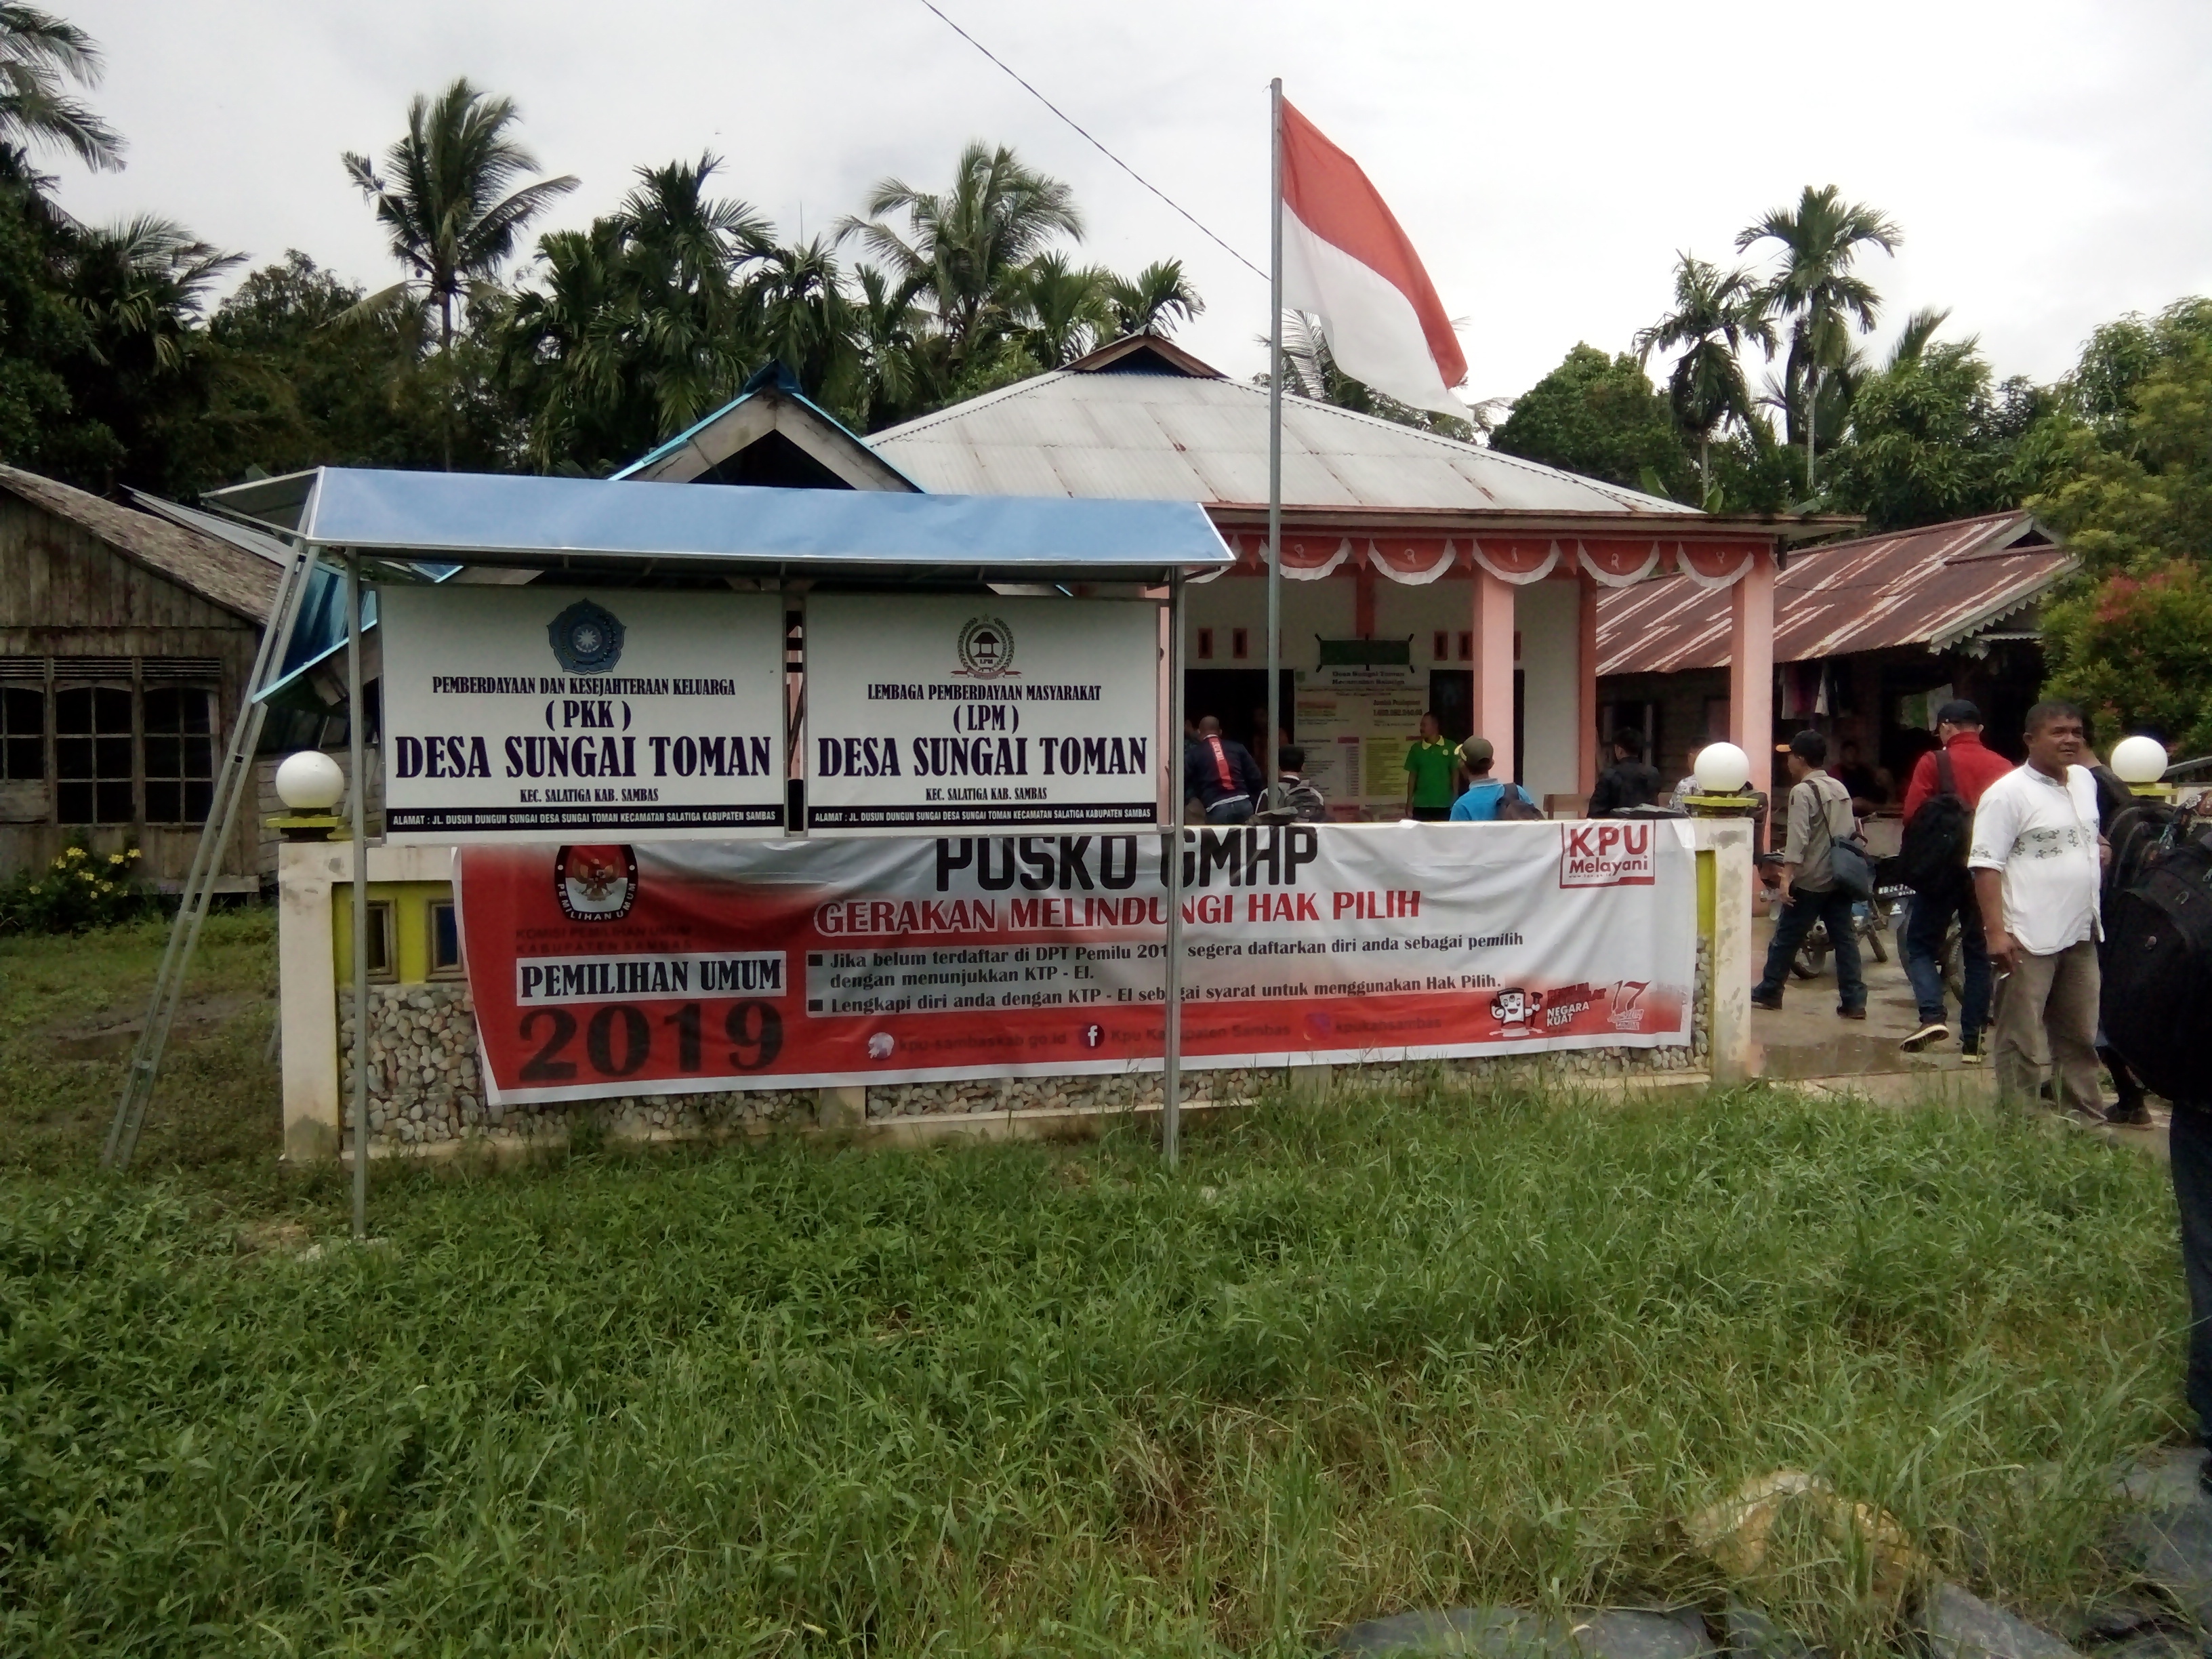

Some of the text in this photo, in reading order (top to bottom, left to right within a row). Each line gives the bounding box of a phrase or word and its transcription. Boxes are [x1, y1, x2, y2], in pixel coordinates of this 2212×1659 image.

[433, 676, 735, 696] PEMBERDAYAAN DAN KESEJAHTERAAN KELUARGA
[868, 684, 1101, 700] LEMBAGA PEMBERDAYAAN MASYARAKAT
[563, 700, 614, 727] PKK
[967, 705, 1006, 731] LPM
[395, 736, 771, 778] DESA SUNGAI TOMAN
[818, 737, 1147, 777] DESA SUNGAI TOMAN
[520, 788, 658, 802] KEC. SALATIGA KAB. SAMBAS
[926, 787, 1046, 800] KEC. SALATIGA KAB. SAMBAS
[393, 815, 425, 825] ALAMAT
[446, 815, 472, 824] DUSUN
[475, 815, 507, 823] DUNGUN
[510, 814, 537, 823] SUNGAI
[540, 814, 559, 823] DESA
[562, 813, 589, 823] SUNGAI
[592, 813, 618, 822] TOMAN
[621, 813, 664, 822] KECAMATAN
[667, 813, 701, 821] SALATIGA
[703, 812, 743, 821] KABUPATEN
[746, 811, 775, 820] SAMBAS
[815, 813, 842, 821] ALAMAT
[861, 813, 884, 821] DUSUN
[916, 812, 941, 820] SUNGAI
[943, 811, 960, 820] DESA
[962, 811, 986, 819] SUNGAI
[988, 811, 1011, 819] TOMAN
[1013, 810, 1052, 819] KECAMATAN
[1054, 810, 1084, 818] SALATIGA
[1086, 809, 1122, 818] KABUPATEN
[1124, 808, 1150, 817] SAMBAS
[1570, 825, 1648, 857] KPU
[1570, 855, 1647, 876] Melayani
[558, 883, 636, 920] PEMILIHAN UMUM
[817, 901, 996, 931] GERAKAN
[1248, 892, 1319, 922] HAK
[1333, 890, 1420, 919] PILIH
[516, 941, 617, 953] KABUPATEN
[830, 953, 866, 968] Jika
[874, 951, 926, 967] belum
[933, 949, 1008, 964] terdaftar
[1015, 947, 1029, 962] di
[1036, 946, 1069, 960] DPT
[1074, 943, 1130, 963] Pemilu
[1188, 944, 1242, 960] segera
[1248, 938, 1326, 955] daftarkan
[1332, 939, 1356, 952] diri
[1362, 937, 1399, 951] anda
[1405, 935, 1462, 951] sebagai
[1469, 933, 1523, 950] pemilih
[521, 959, 781, 998] PEMILIHAN UMUM
[830, 972, 895, 991] dengan
[903, 968, 1018, 986] menunjukkan
[1025, 966, 1057, 981] KTP
[832, 996, 914, 1017] Lengkapi
[918, 994, 947, 1009] diri
[954, 993, 995, 1007] anda
[1002, 991, 1061, 1008] dengan
[1069, 989, 1101, 1003] KTP
[1206, 984, 1255, 1001] syarat
[1263, 983, 1308, 996] untuk
[1312, 979, 1422, 1000] menggunakan
[1427, 976, 1456, 989] Hak
[1461, 975, 1500, 988] Pilih.
[1611, 980, 1652, 1010] 17
[1547, 1002, 1590, 1017] NEGARA
[1547, 1013, 1573, 1027] KUAT
[519, 1001, 783, 1082] 2019
